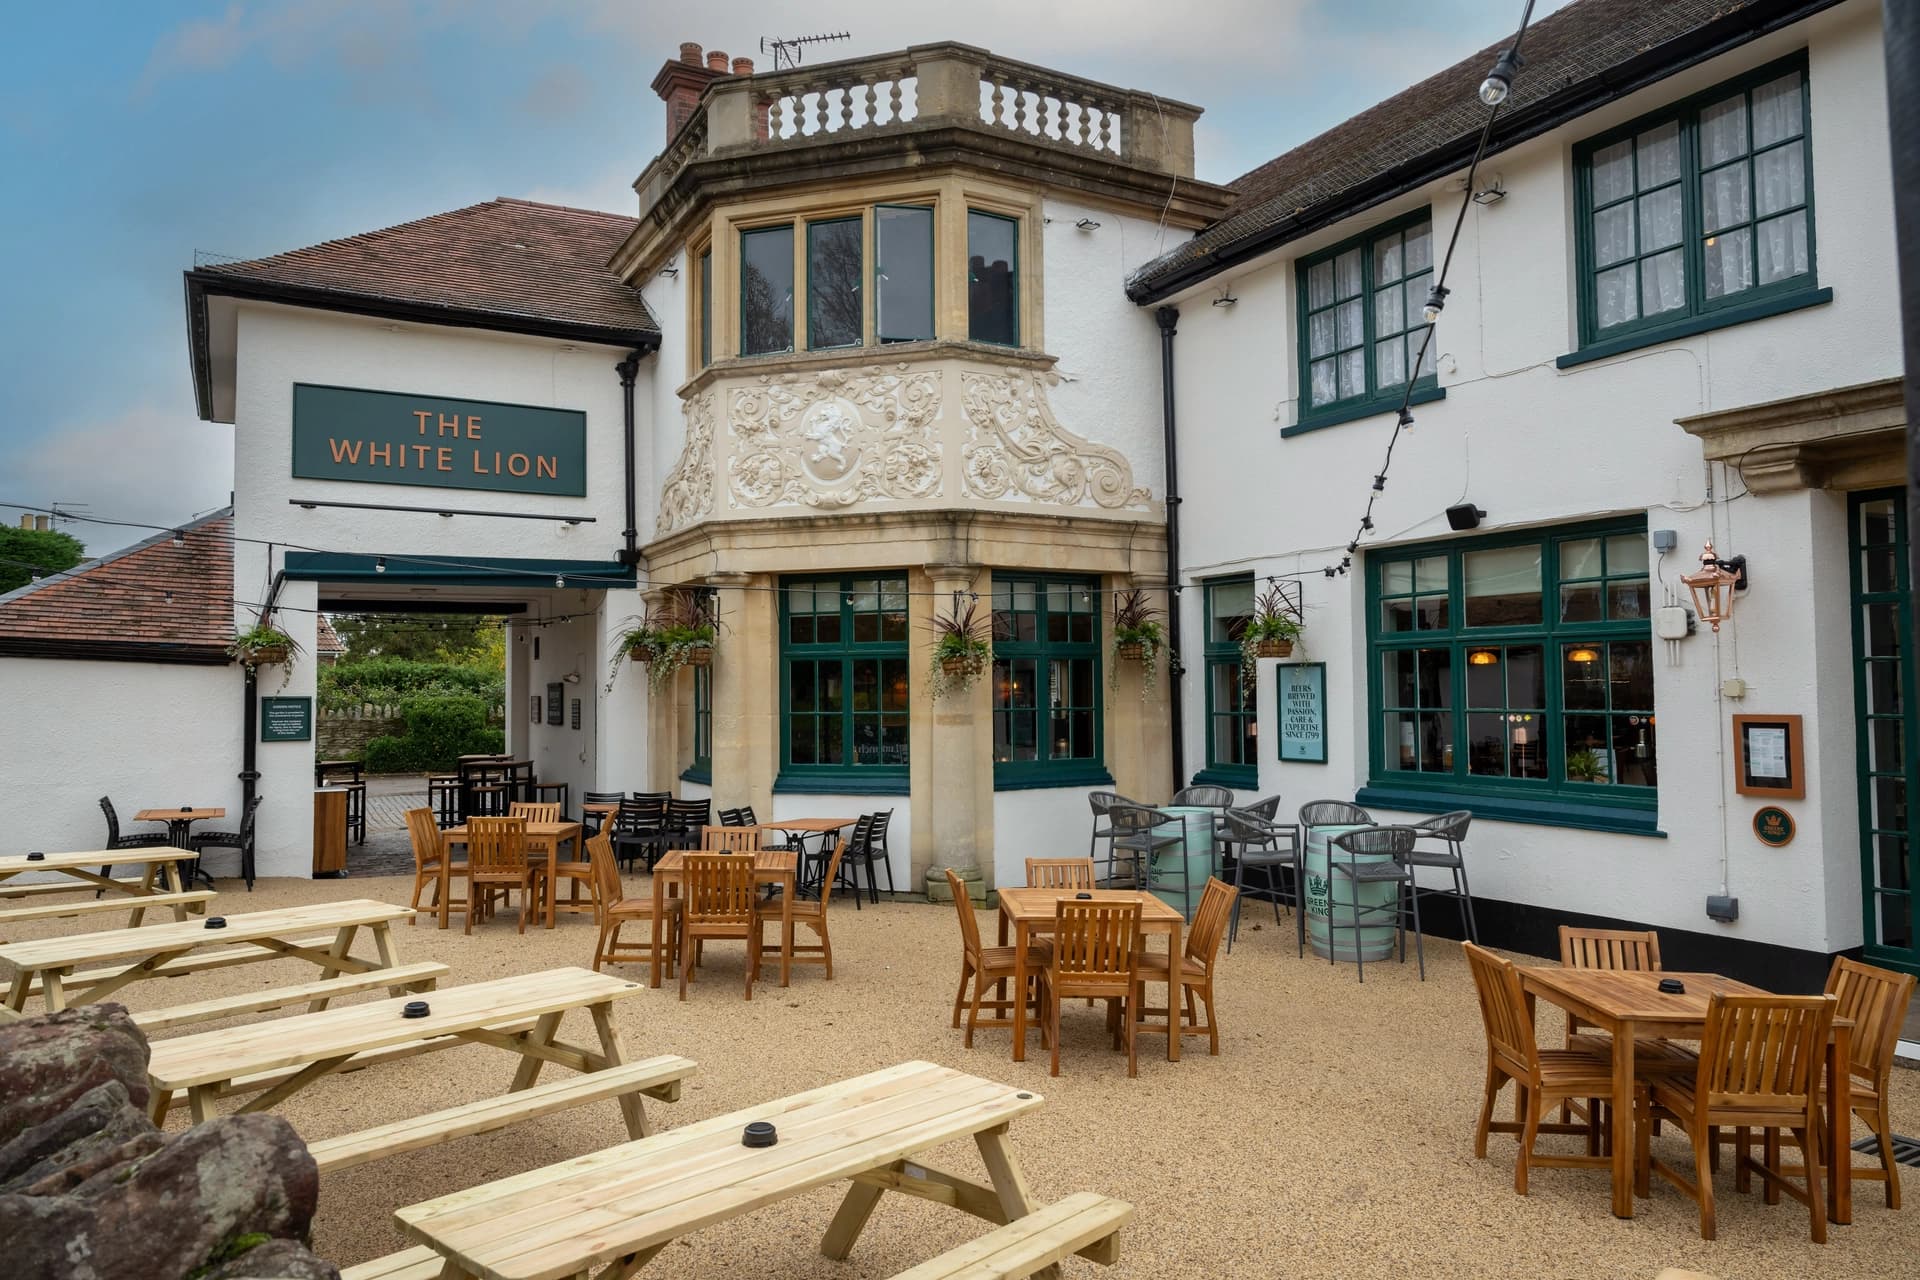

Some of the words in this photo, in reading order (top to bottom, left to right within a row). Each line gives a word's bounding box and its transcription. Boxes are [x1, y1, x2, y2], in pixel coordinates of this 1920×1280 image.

[412, 410, 482, 440] THE
[329, 438, 453, 472] WHITE
[473, 449, 558, 479] LION
[1288, 692, 1315, 700] BREWED
[1287, 708, 1317, 716] PASSION,
[1290, 715, 1306, 723] CARE
[1285, 723, 1319, 731] EXPERTISE
[1285, 731, 1304, 739] SINCE
[1305, 731, 1320, 740] 1799
